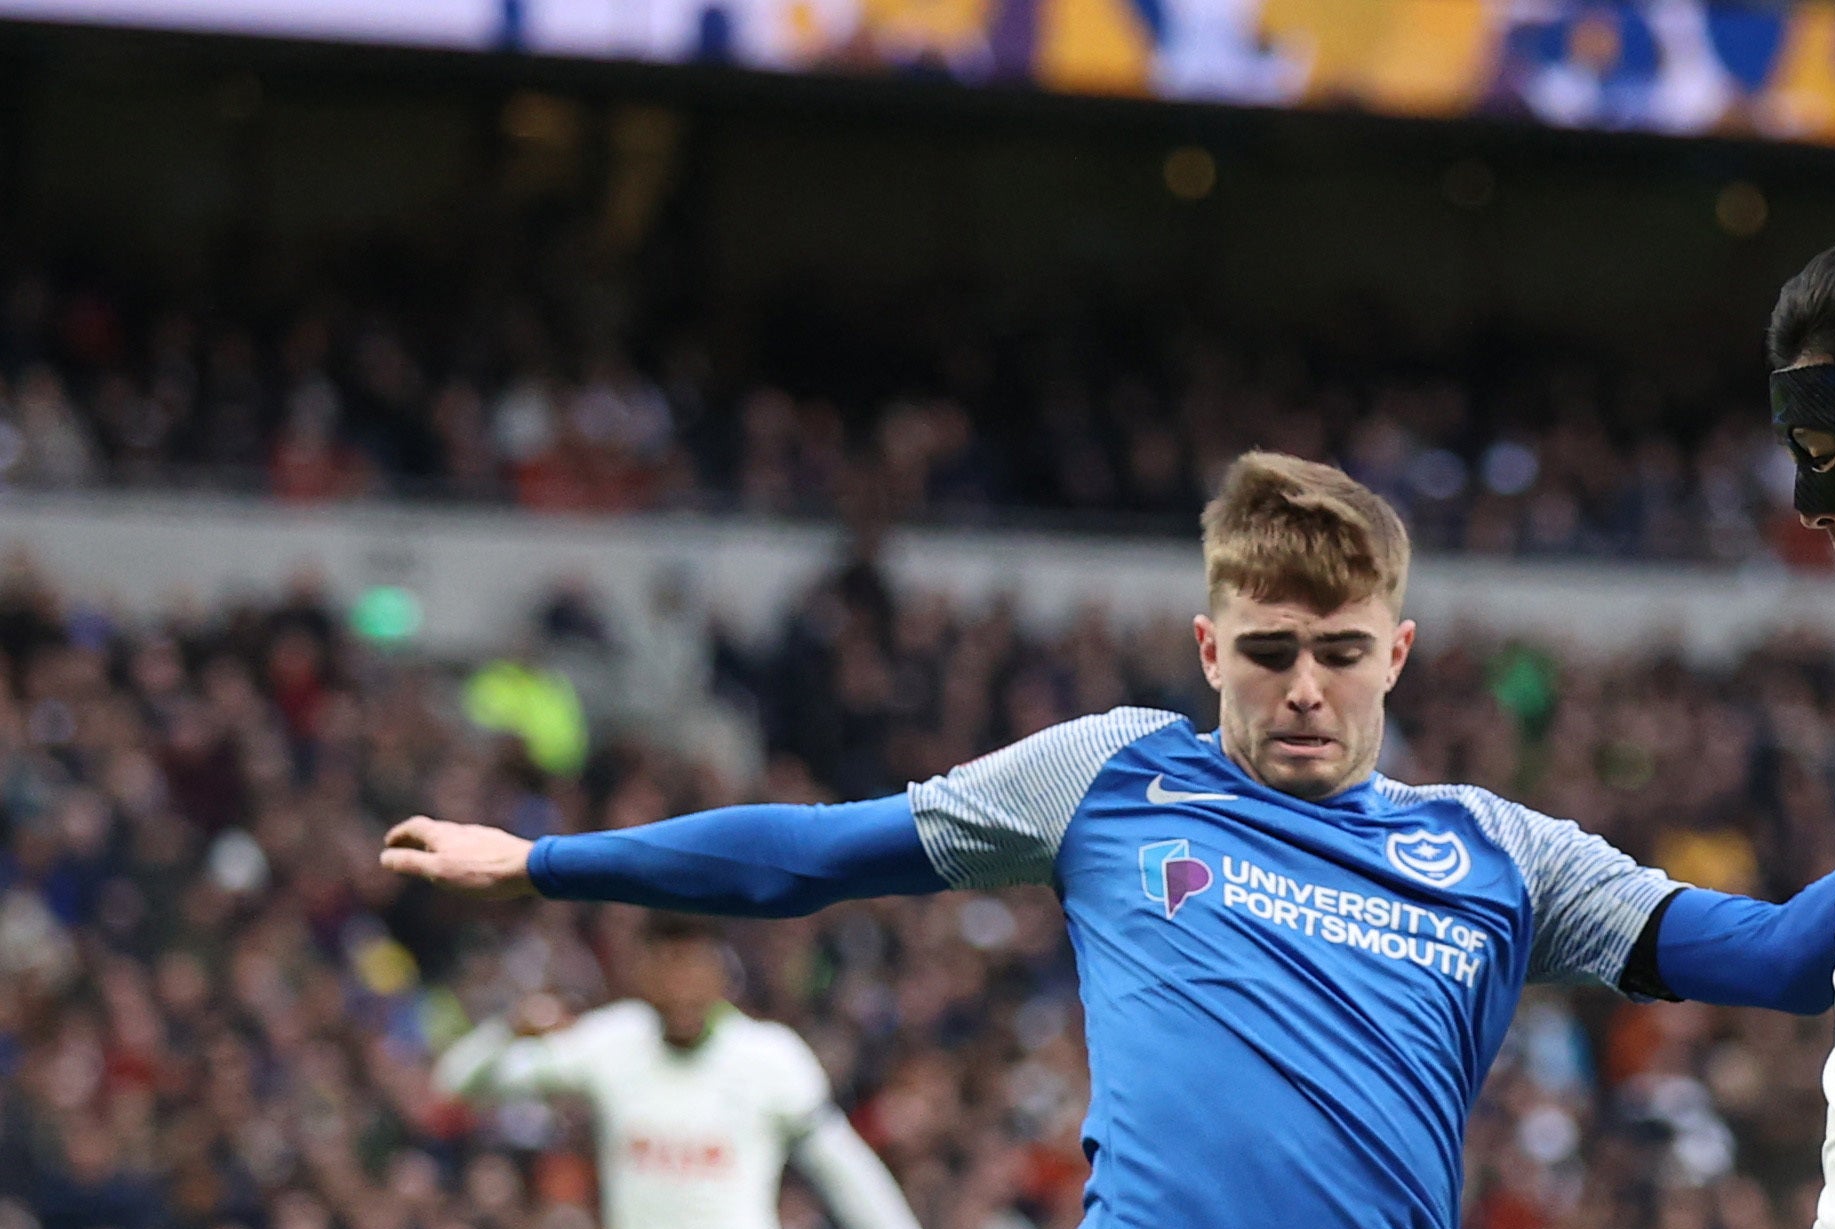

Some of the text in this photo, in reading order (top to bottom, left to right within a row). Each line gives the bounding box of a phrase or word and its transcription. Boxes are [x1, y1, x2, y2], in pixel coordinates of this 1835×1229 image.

[1223, 856, 1488, 952] UNIVERSITY OF
[1223, 884, 1482, 988] PORTSMOUTH
